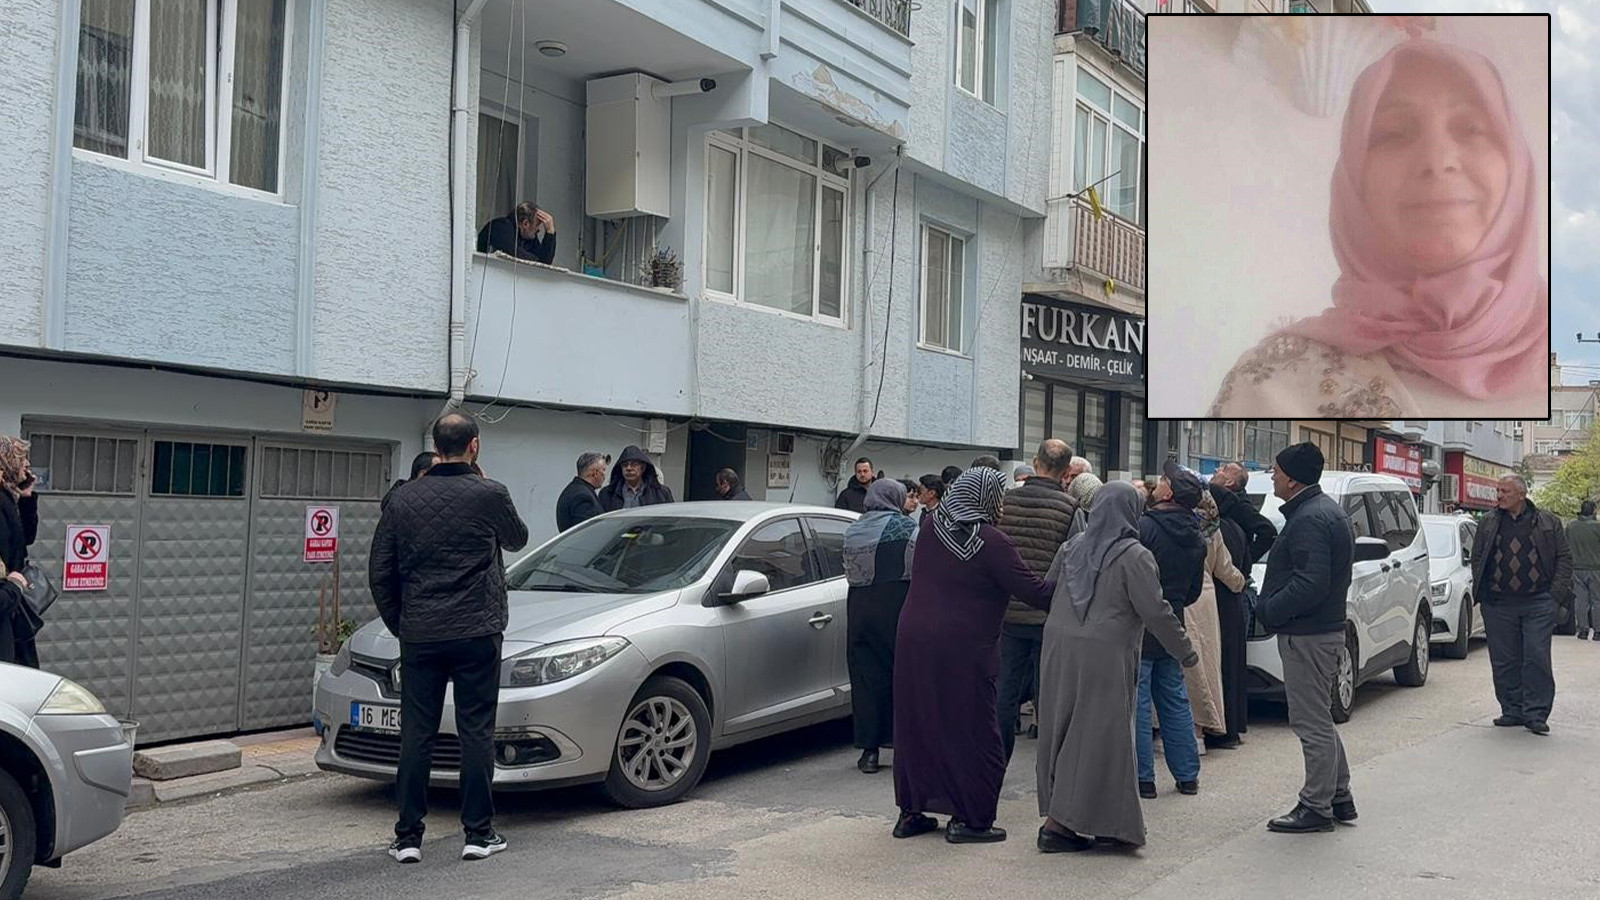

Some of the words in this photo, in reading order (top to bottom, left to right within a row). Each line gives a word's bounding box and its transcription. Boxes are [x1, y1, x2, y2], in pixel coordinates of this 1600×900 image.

[1021, 302, 1145, 355] FURKAN
[1066, 354, 1101, 371] DEMİR
[1107, 358, 1133, 376] ÇELİK
[70, 563, 86, 573] GARAJ
[362, 706, 373, 725] 16
